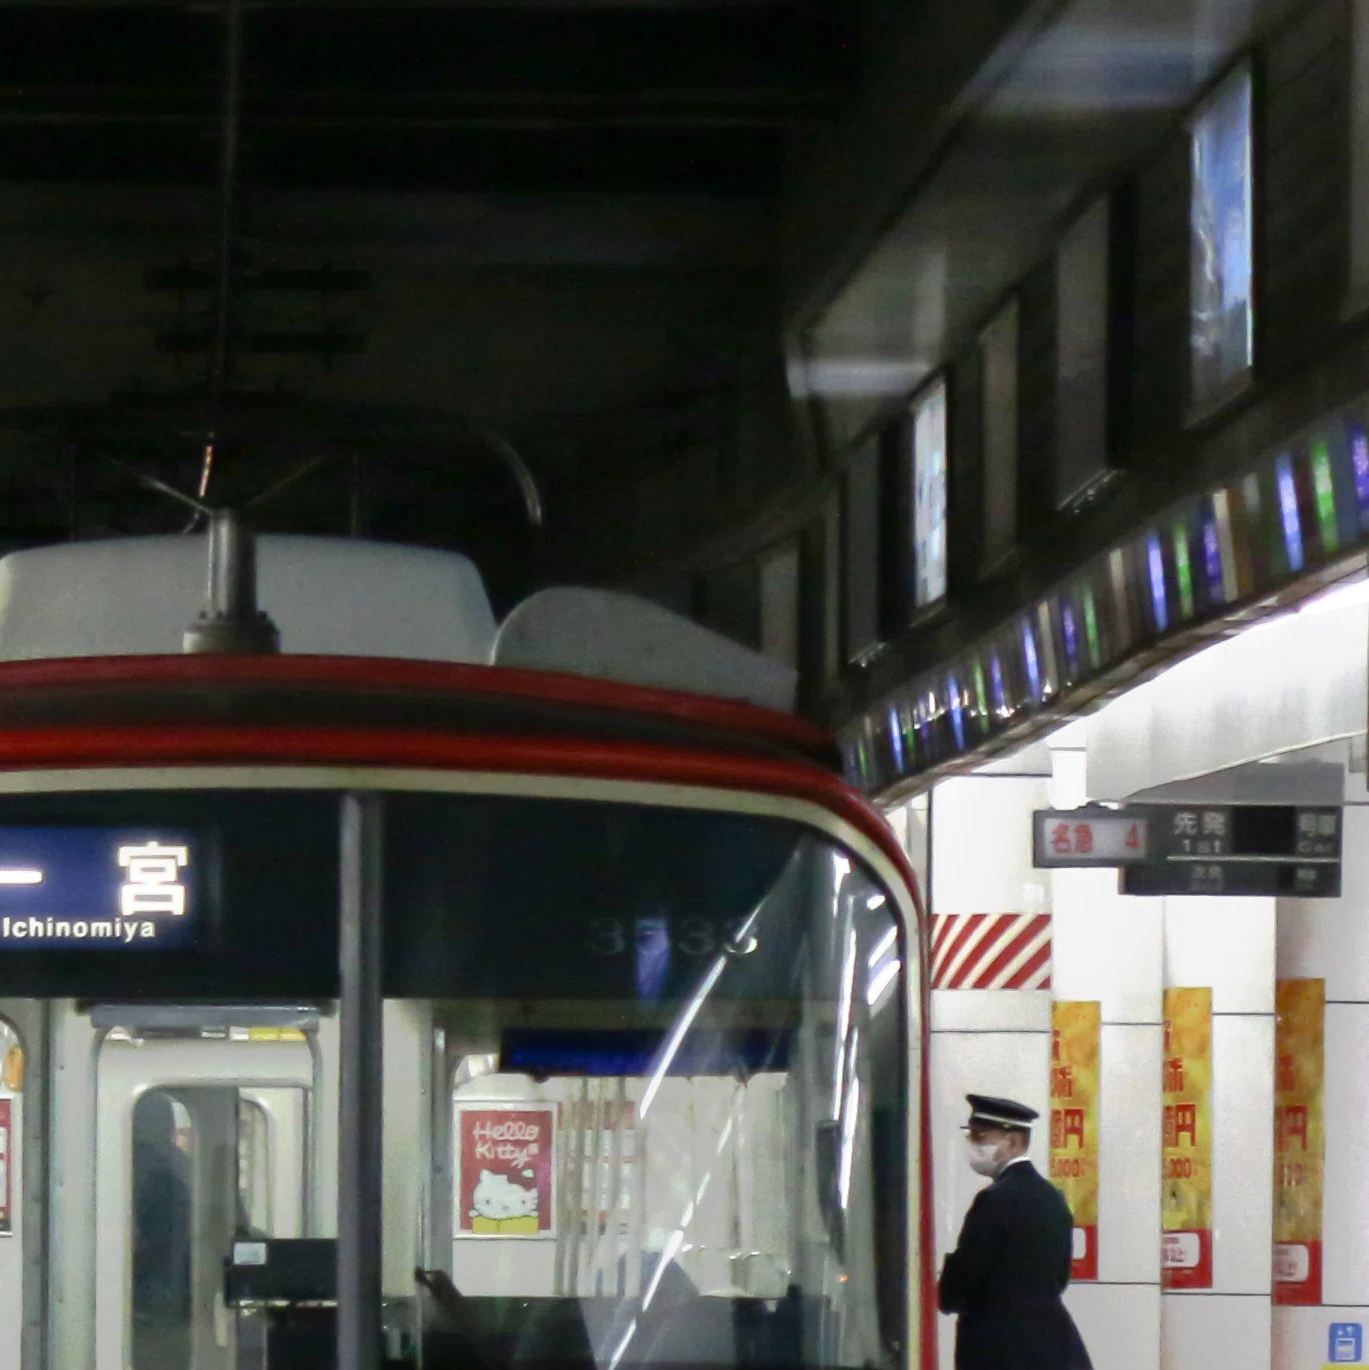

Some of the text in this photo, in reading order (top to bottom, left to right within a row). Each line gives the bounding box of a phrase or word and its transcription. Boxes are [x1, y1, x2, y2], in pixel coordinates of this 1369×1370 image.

[1125, 823, 1140, 849] 4
[2, 917, 156, 942] Ichinomiya
[473, 1120, 541, 1142] Hello
[474, 1142, 532, 1168] Kitty
